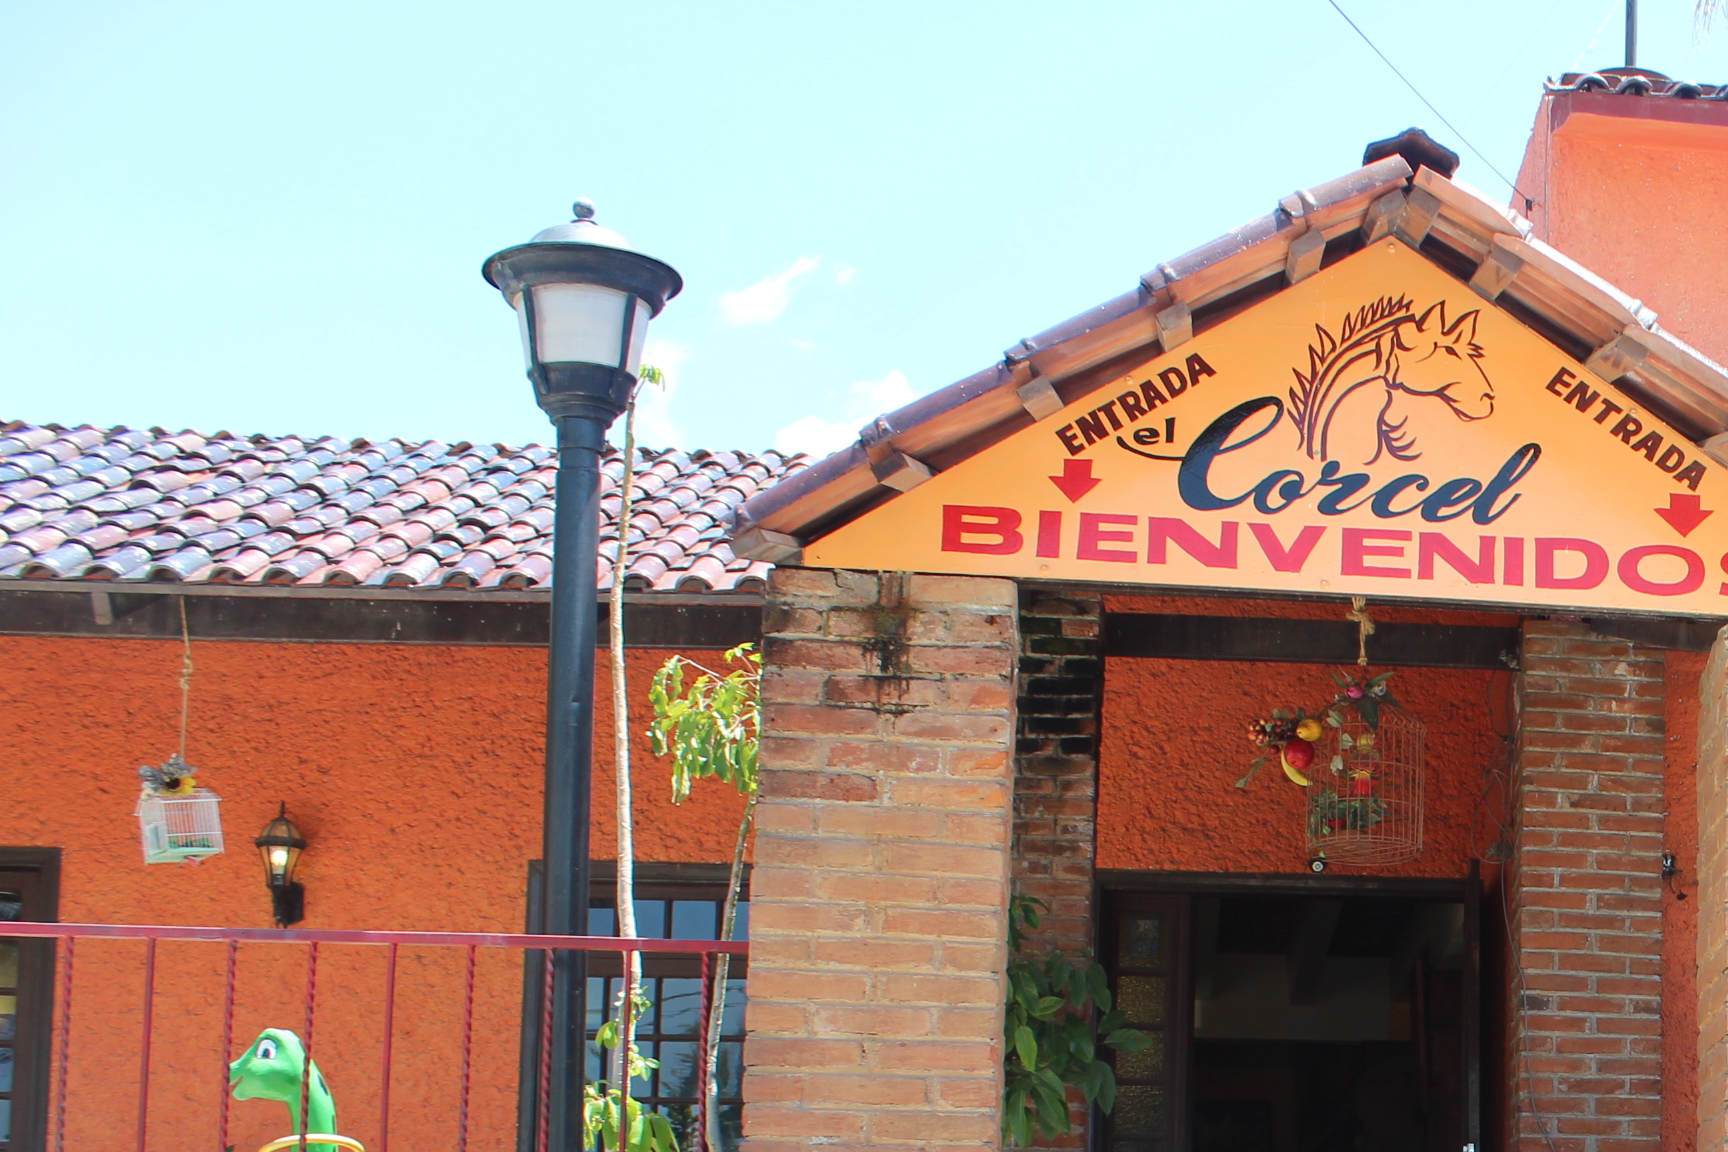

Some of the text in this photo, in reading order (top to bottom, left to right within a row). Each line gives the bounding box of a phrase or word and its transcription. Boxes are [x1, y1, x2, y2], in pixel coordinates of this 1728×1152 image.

[1055, 352, 1218, 457] ENTRADA
[1117, 395, 1542, 525] el Corcel
[1544, 366, 1708, 493] ENTRADA
